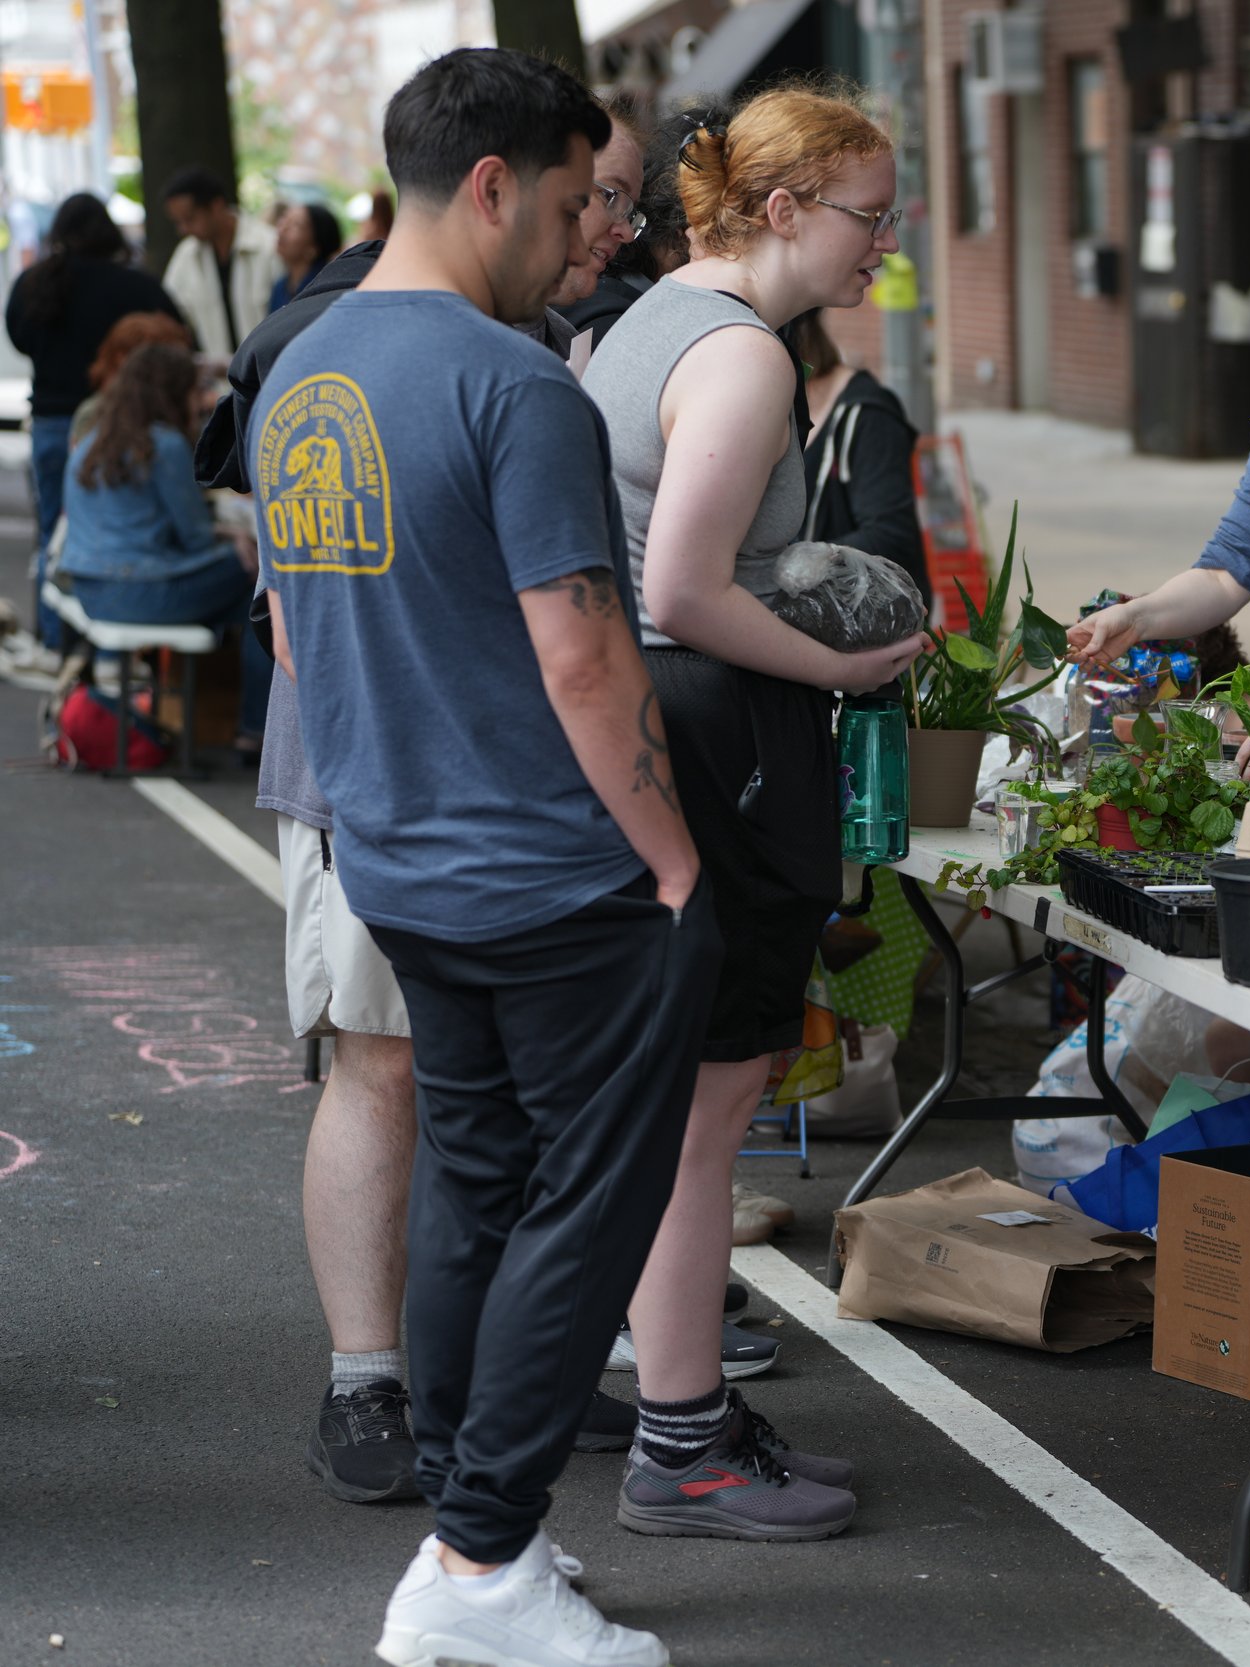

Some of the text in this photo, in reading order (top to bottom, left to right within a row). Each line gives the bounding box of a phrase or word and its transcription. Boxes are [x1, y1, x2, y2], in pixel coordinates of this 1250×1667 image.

[271, 426, 292, 486] DESIGNED
[290, 408, 309, 431] AND
[309, 402, 338, 418] TESTED
[276, 386, 316, 427] FINEST
[353, 412, 380, 498] COMPANY
[1192, 1202, 1236, 1223] Sustainable
[1201, 1216, 1226, 1231] Future
[1198, 1333, 1219, 1347] Nature
